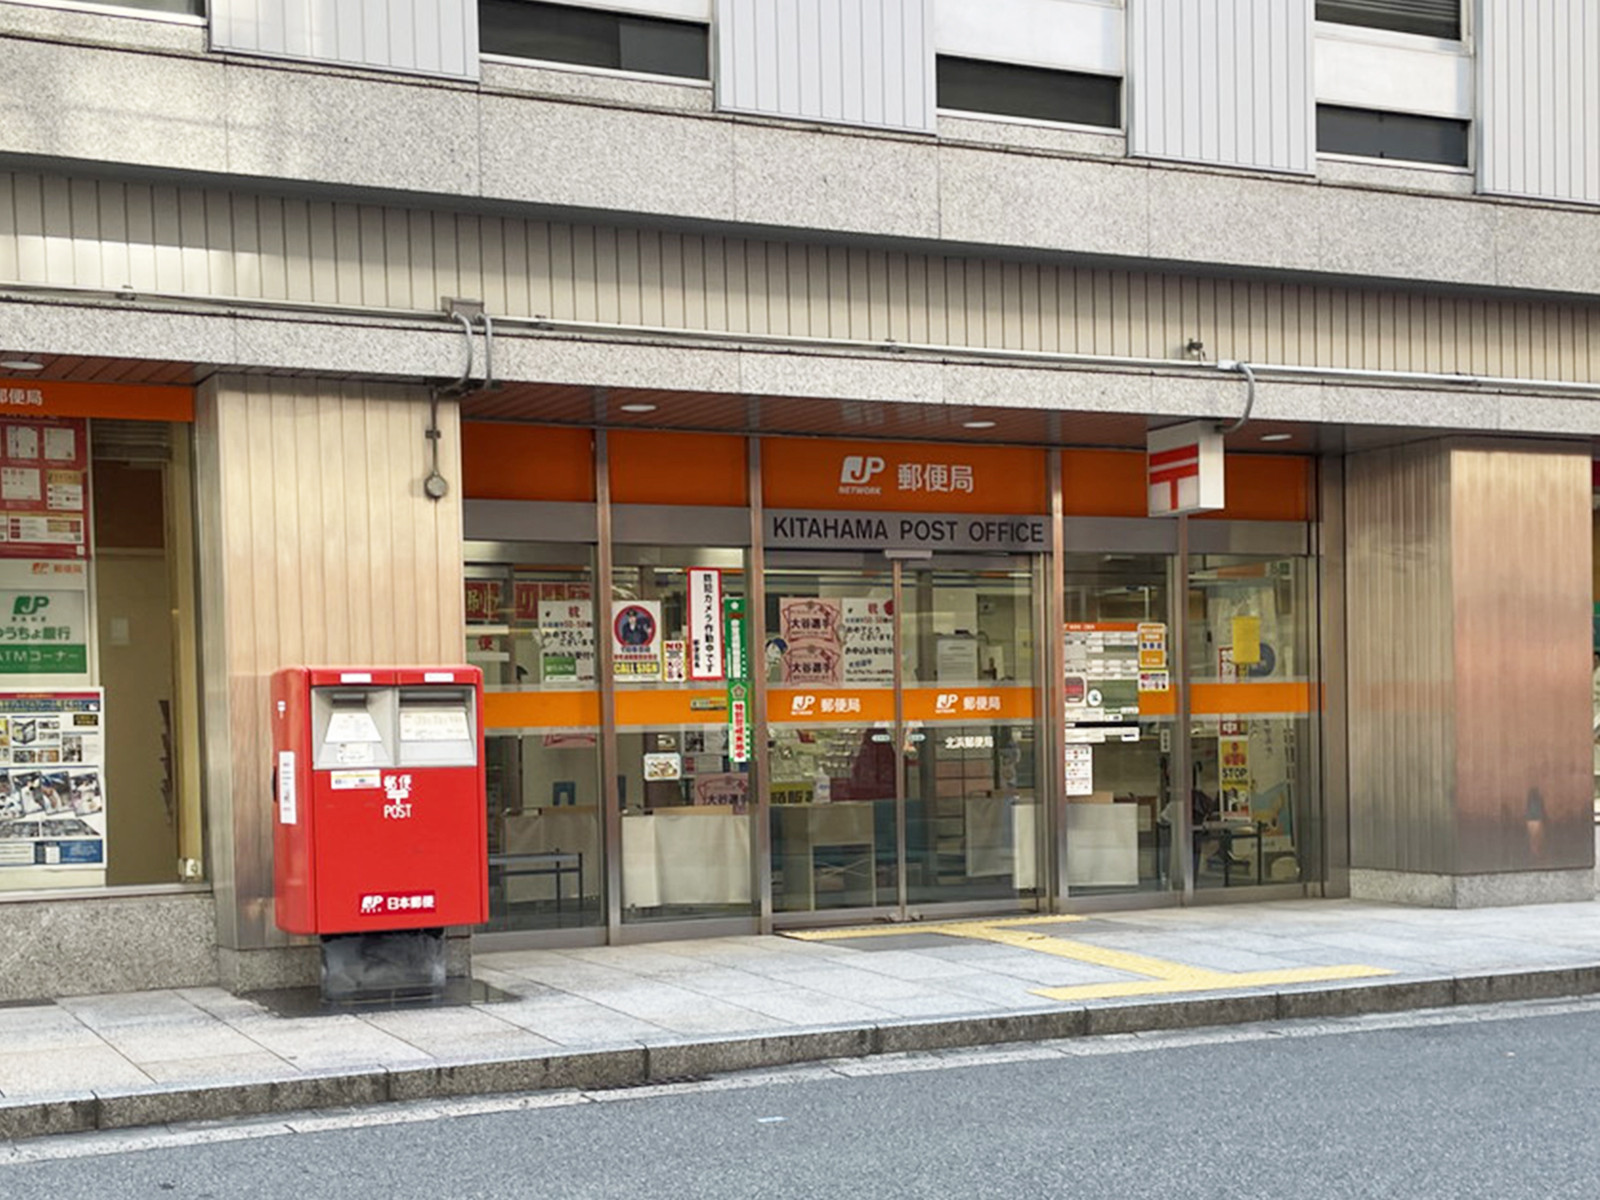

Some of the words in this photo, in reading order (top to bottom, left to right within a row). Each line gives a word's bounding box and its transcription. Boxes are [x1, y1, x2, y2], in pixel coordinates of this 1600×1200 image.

[841, 456, 886, 484] JP
[898, 463, 974, 493] 郵便局
[838, 486, 881, 496] NETWORK
[773, 517, 888, 540] KITAHAMA
[900, 520, 958, 541] POST
[968, 522, 1044, 543] OFFICE
[13, 596, 49, 615] JP
[821, 698, 861, 713] 郵便局
[963, 697, 1001, 711] 郵便局
[1222, 768, 1247, 778] STOP
[384, 804, 412, 819] POST
[387, 895, 435, 910] 日本郵便
